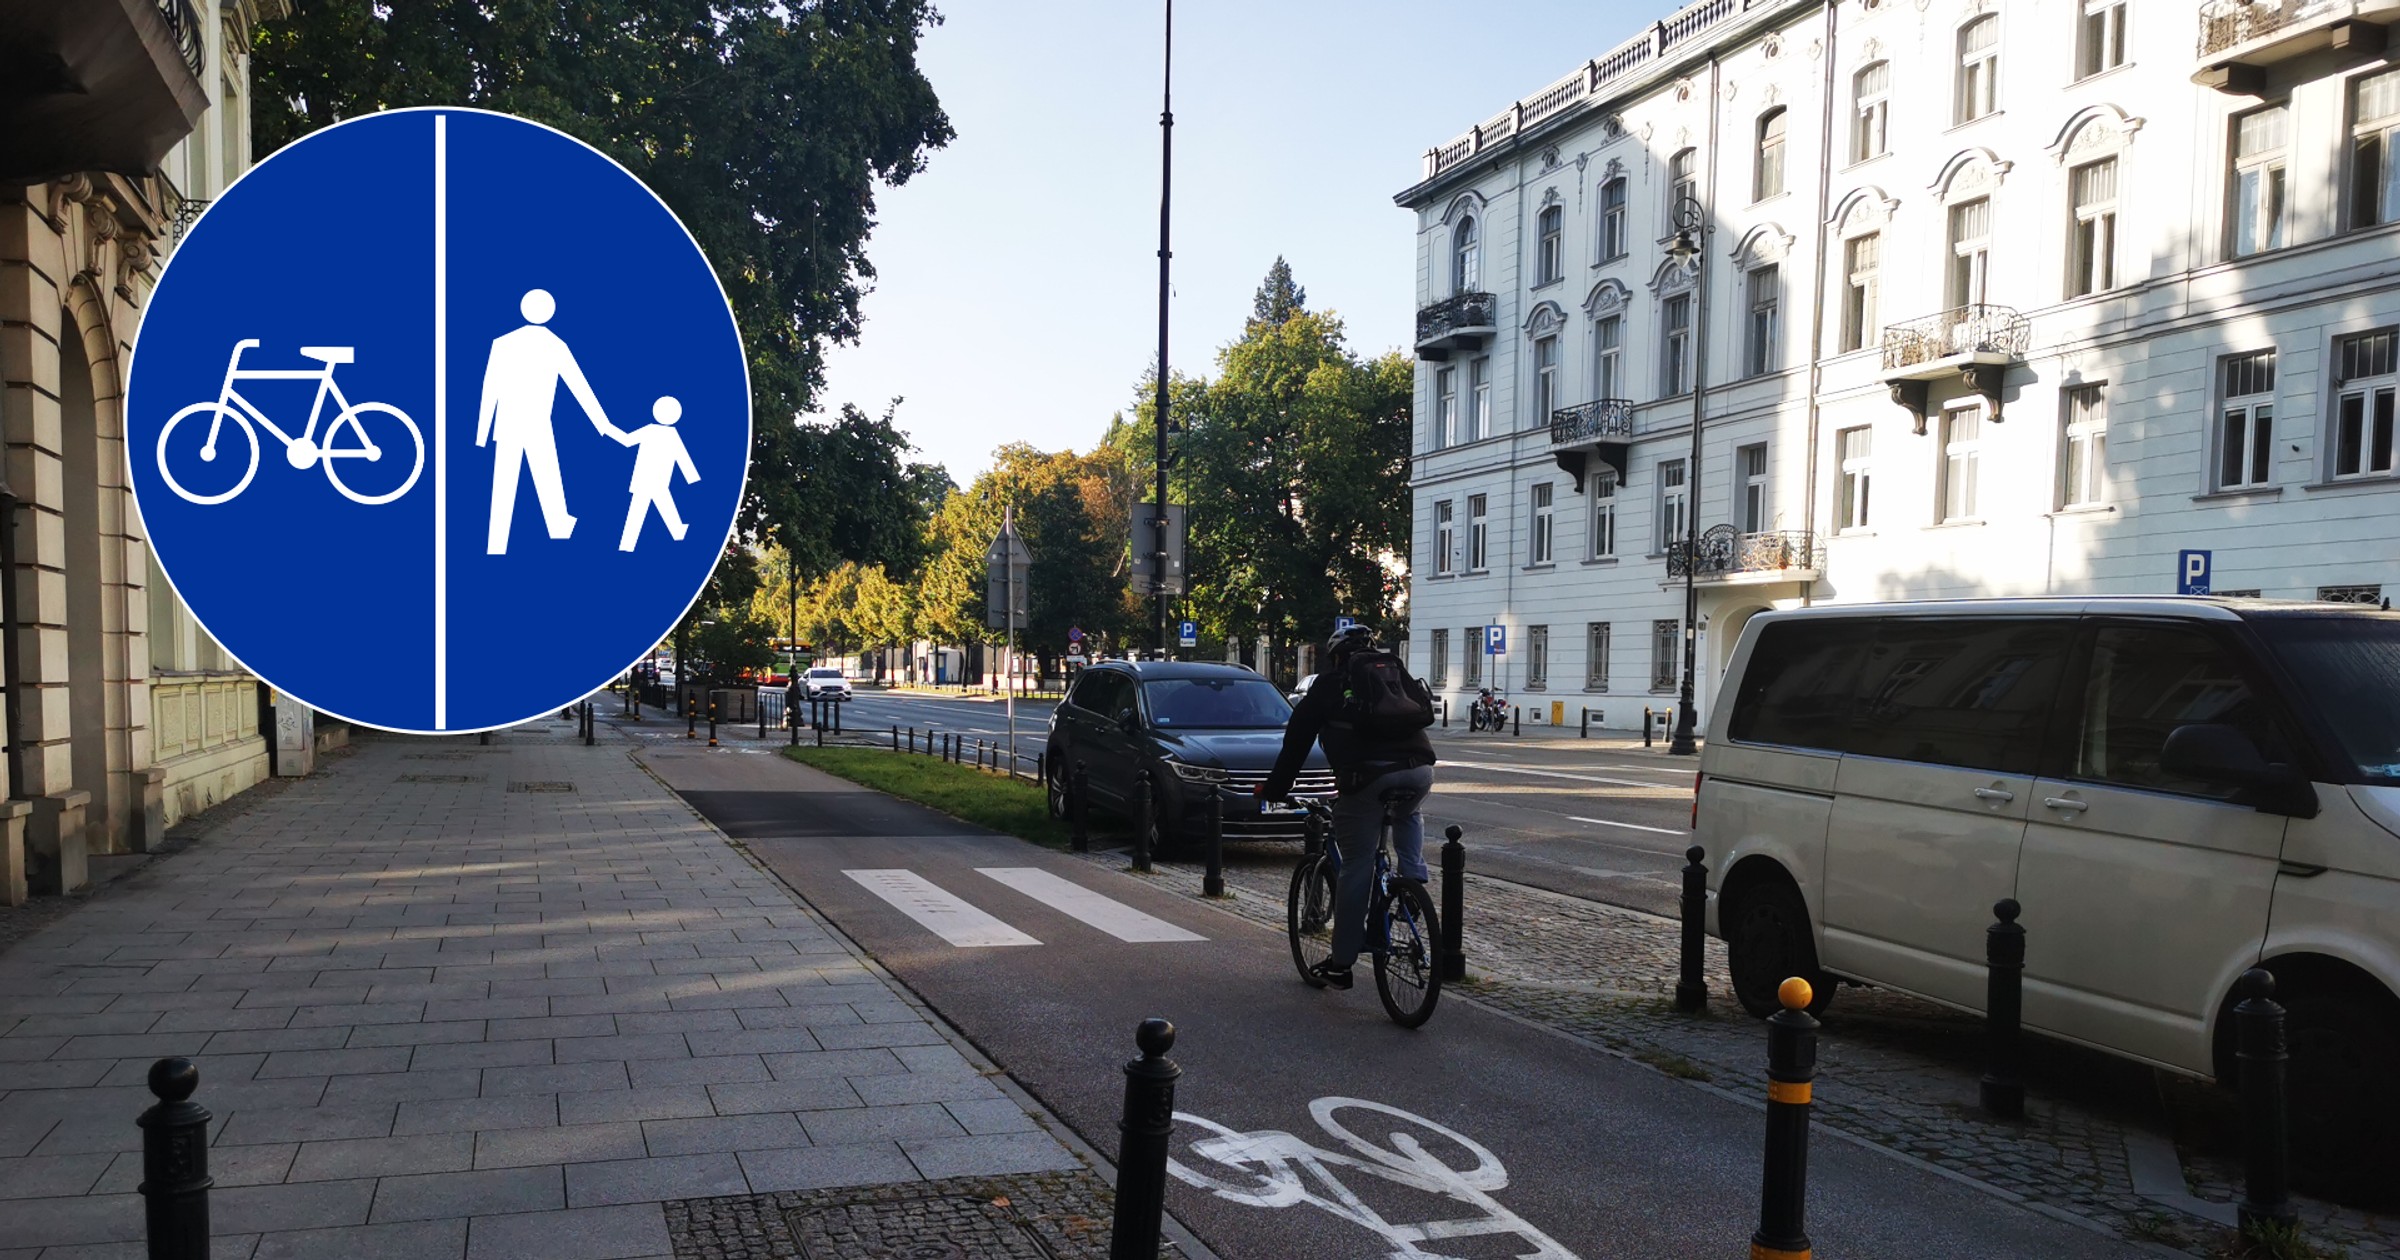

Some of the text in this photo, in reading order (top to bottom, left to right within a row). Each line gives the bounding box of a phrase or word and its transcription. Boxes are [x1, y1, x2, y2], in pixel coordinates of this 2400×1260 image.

[2186, 554, 2205, 585] P
[1184, 623, 1193, 637] P
[1490, 628, 1502, 646] P
